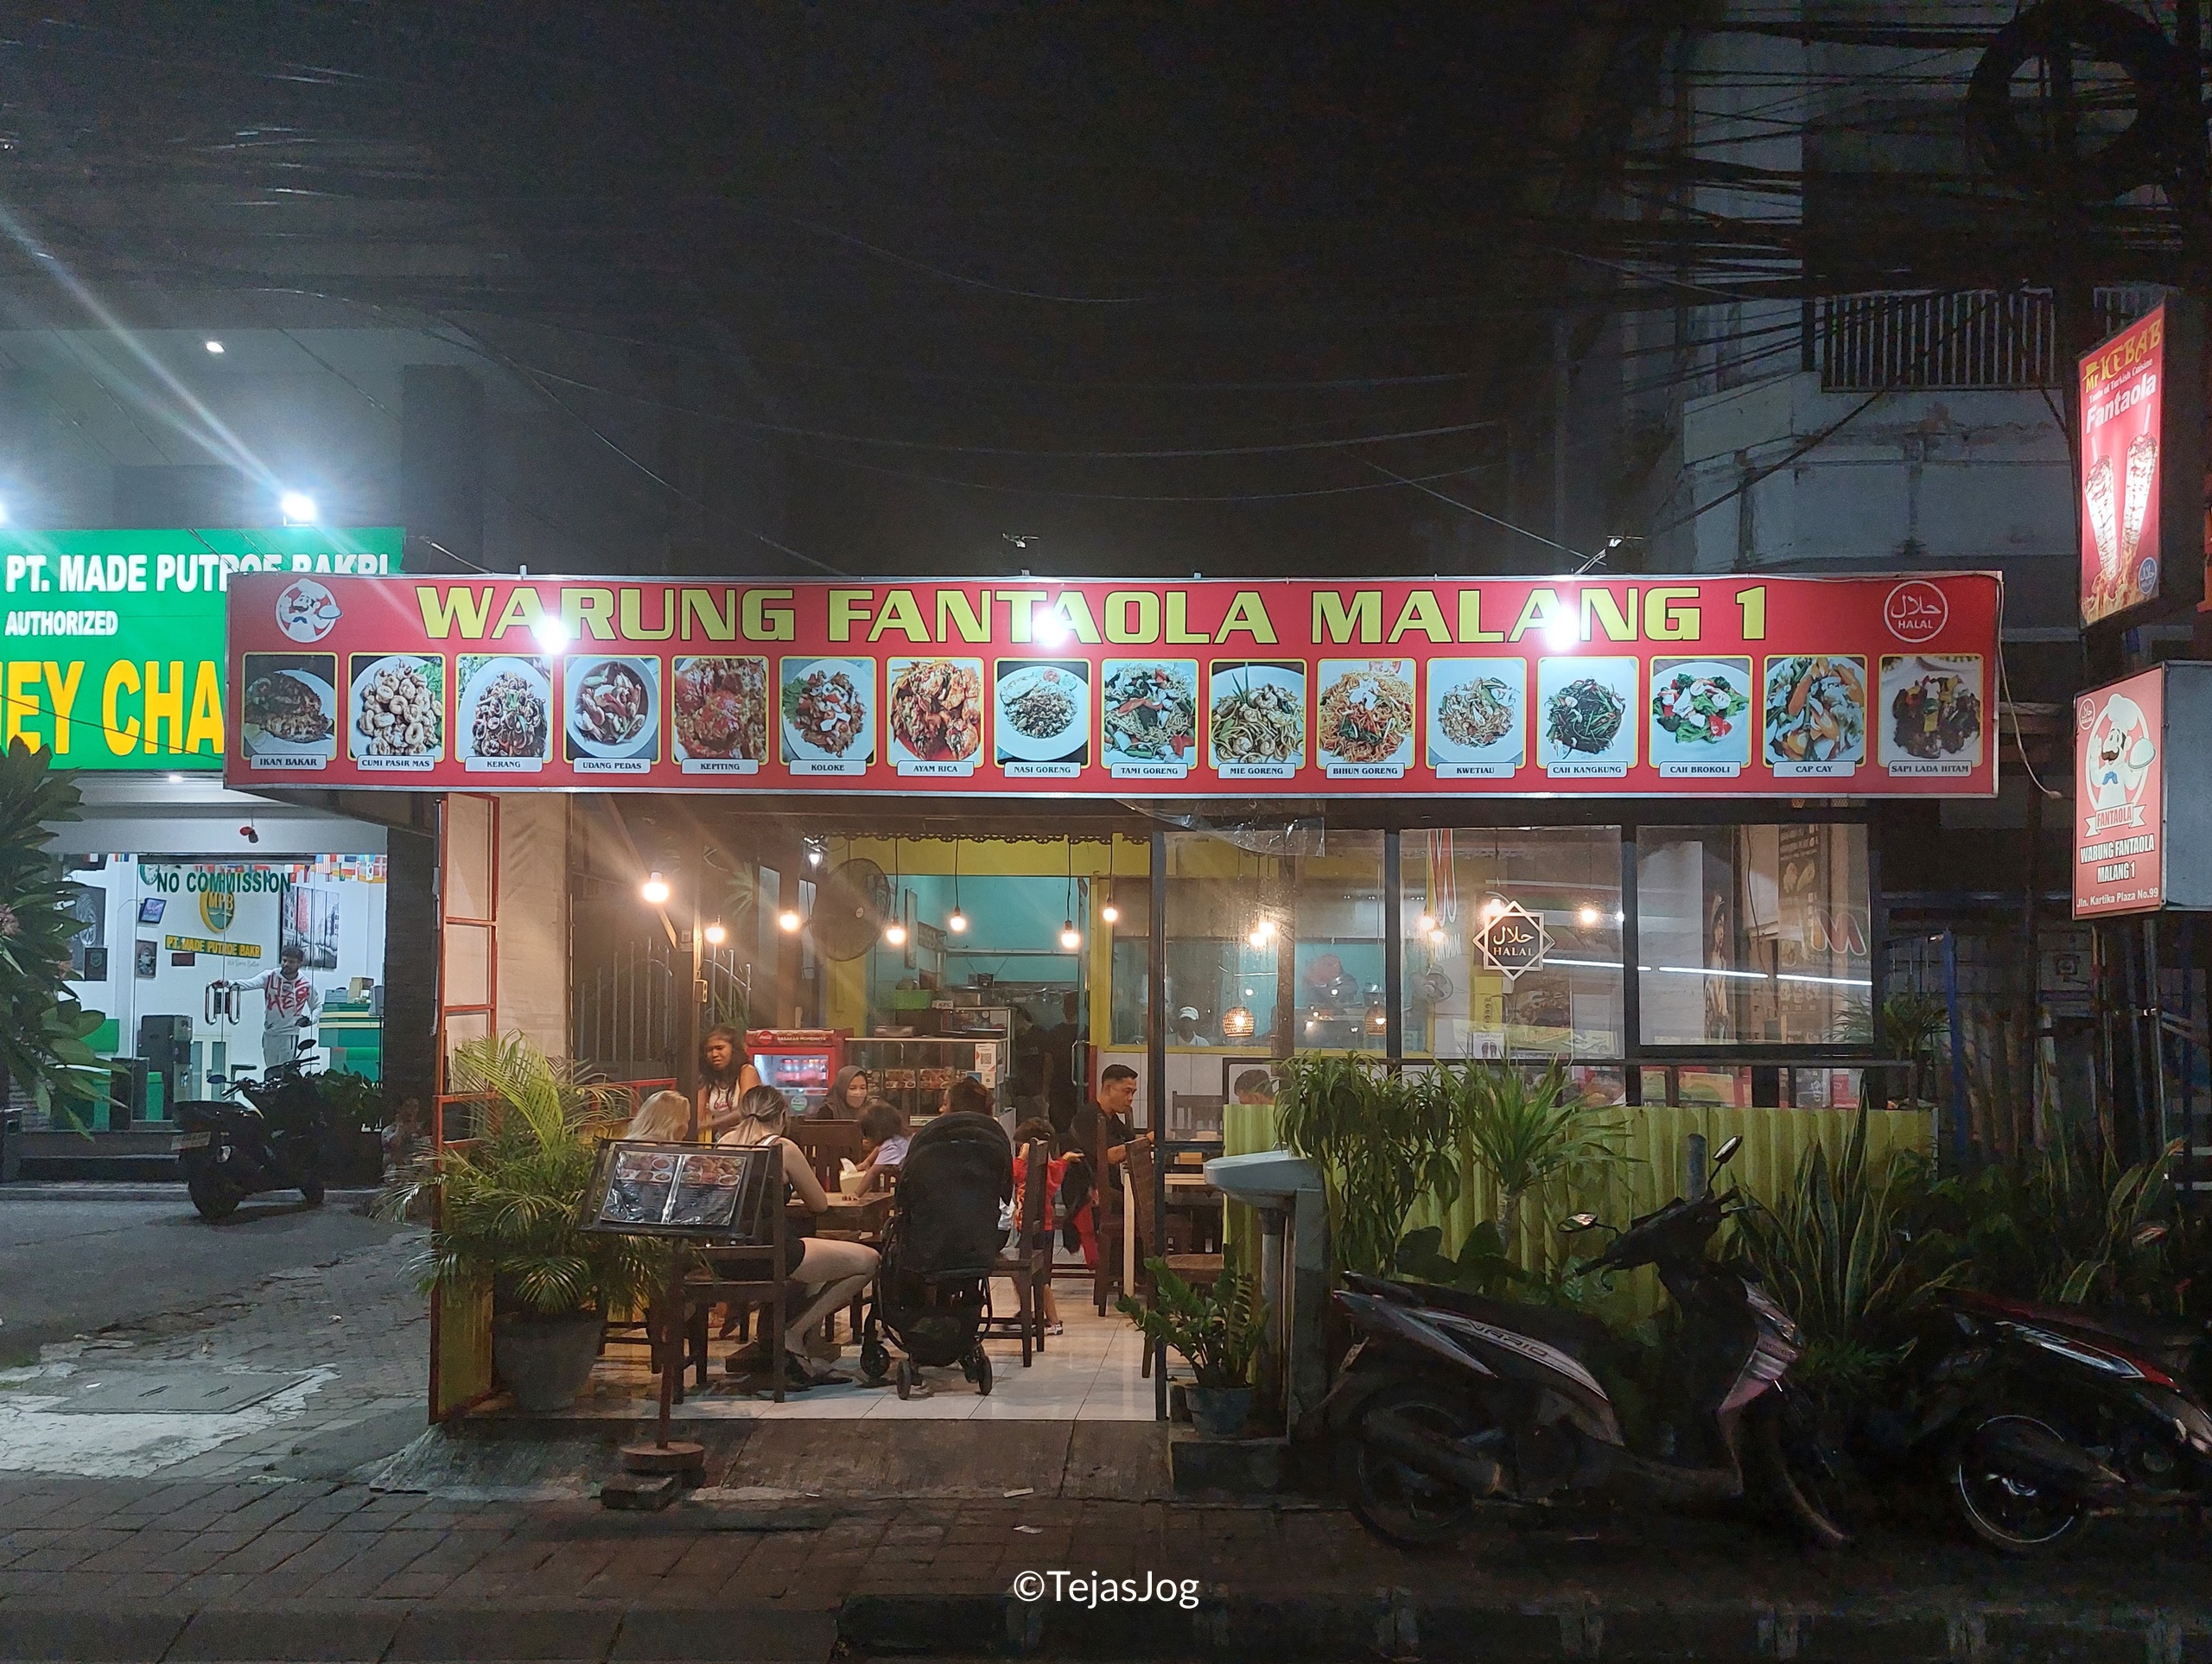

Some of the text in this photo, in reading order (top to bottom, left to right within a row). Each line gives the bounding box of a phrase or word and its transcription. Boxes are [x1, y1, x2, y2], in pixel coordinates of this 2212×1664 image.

[2085, 317, 2161, 394] Mr KEBAB
[2086, 372, 2157, 434] Fantaola
[6, 554, 50, 593] PT.
[59, 554, 148, 593] MADE
[415, 585, 1767, 645] WARUNG FANTAOLA MALANG 1
[1890, 594, 1942, 619] حلال
[4, 610, 118, 637] AUTHORIZED
[1897, 619, 1934, 630] HALAL
[0, 660, 86, 755] EY
[259, 758, 317, 766] IKAN BAKAR
[1035, 765, 1071, 774] GORENG
[1891, 765, 1969, 773] SAPI LADA HITAM
[2097, 806, 2133, 828] FANTAOLA
[2080, 833, 2155, 864] WARUNG FANTAOLA
[157, 872, 291, 893] NO COMMISSION
[2097, 860, 2136, 884] MALANG 1
[207, 892, 234, 911] MPB
[2076, 887, 2159, 908] Jln. Kartika Plaza No.99
[181, 937, 205, 952] MADE
[1492, 925, 1535, 945] حلال
[1492, 946, 1535, 956] HALAL
